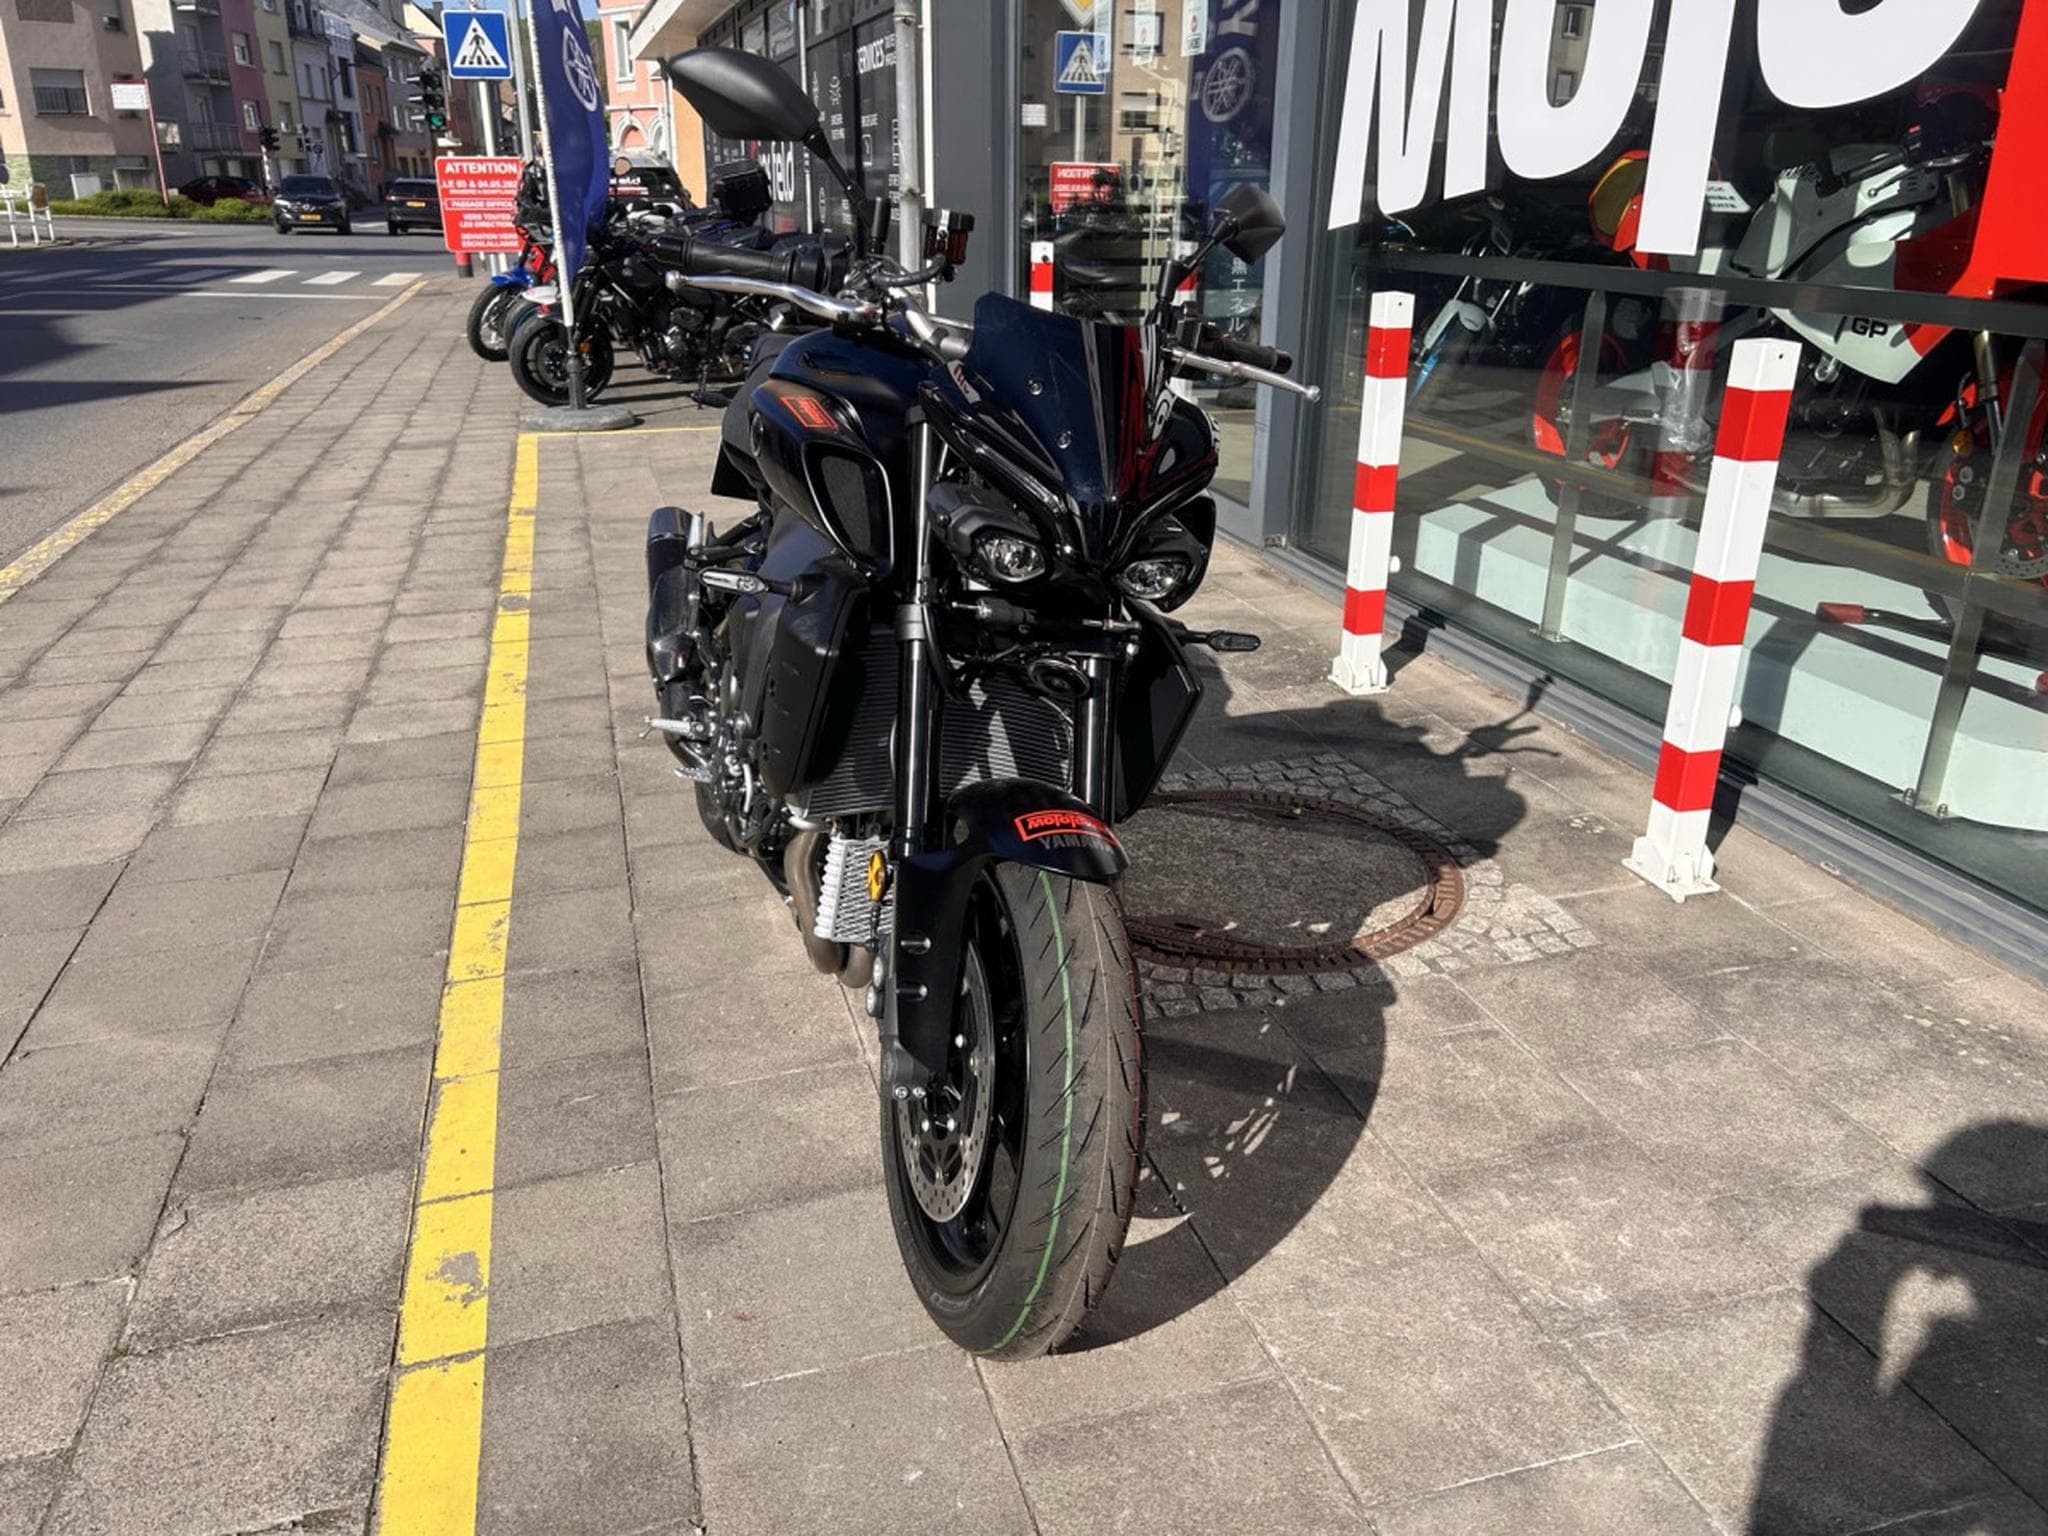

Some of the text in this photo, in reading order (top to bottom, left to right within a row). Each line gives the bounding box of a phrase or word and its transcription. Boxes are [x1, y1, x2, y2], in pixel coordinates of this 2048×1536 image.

[445, 162, 518, 174] ATTENTION
[478, 180, 518, 189] 04.05.202
[451, 200, 484, 208] PASSAGE
[1852, 317, 1888, 338] GP
